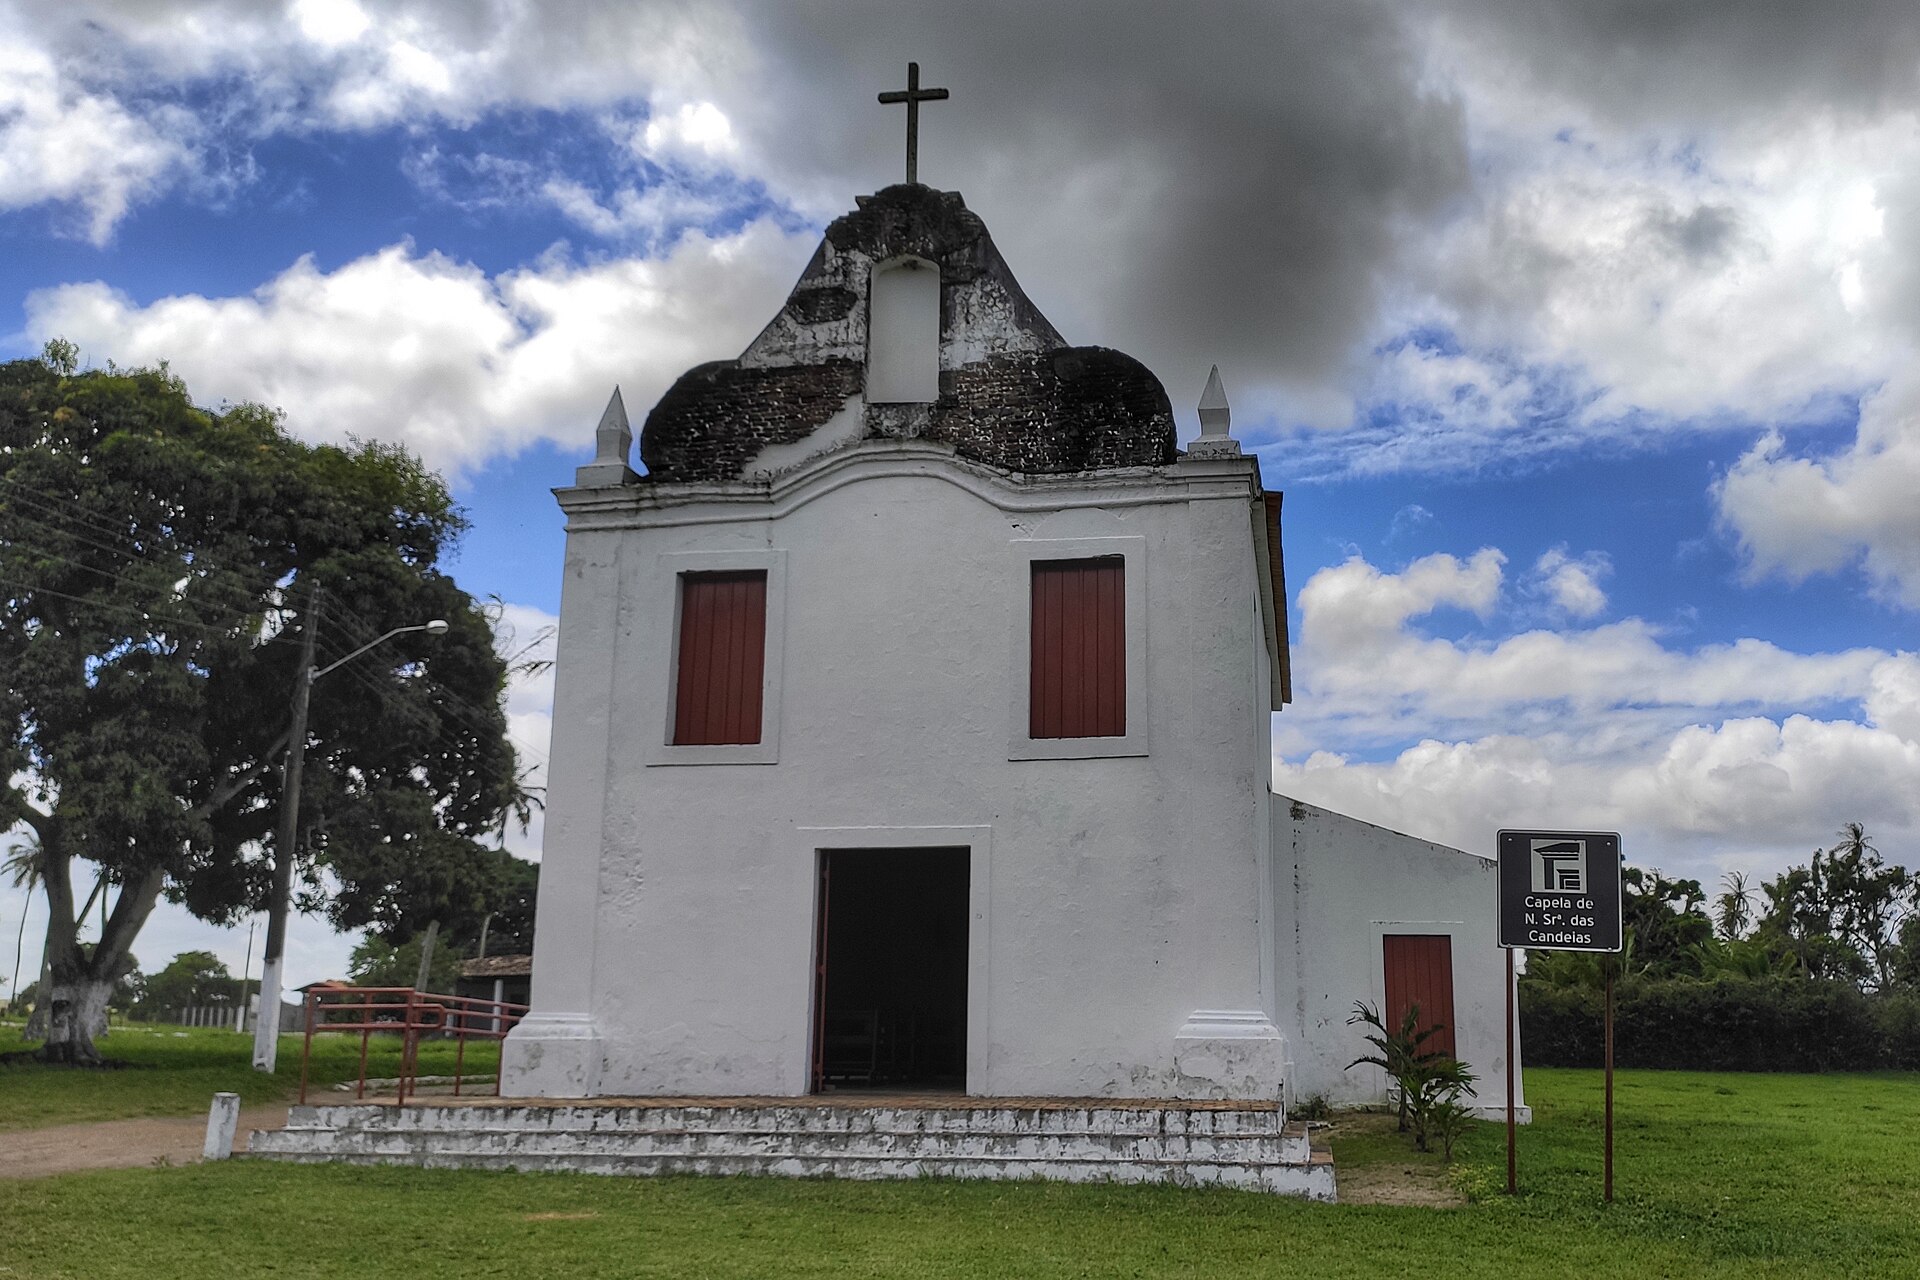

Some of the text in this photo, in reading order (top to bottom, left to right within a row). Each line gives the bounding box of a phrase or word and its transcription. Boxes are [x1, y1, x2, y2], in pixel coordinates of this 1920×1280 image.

[1525, 896, 1594, 911] Capela de
[1525, 913, 1539, 925] N.
[1570, 915, 1594, 926] das
[1529, 930, 1591, 943] Candeias
